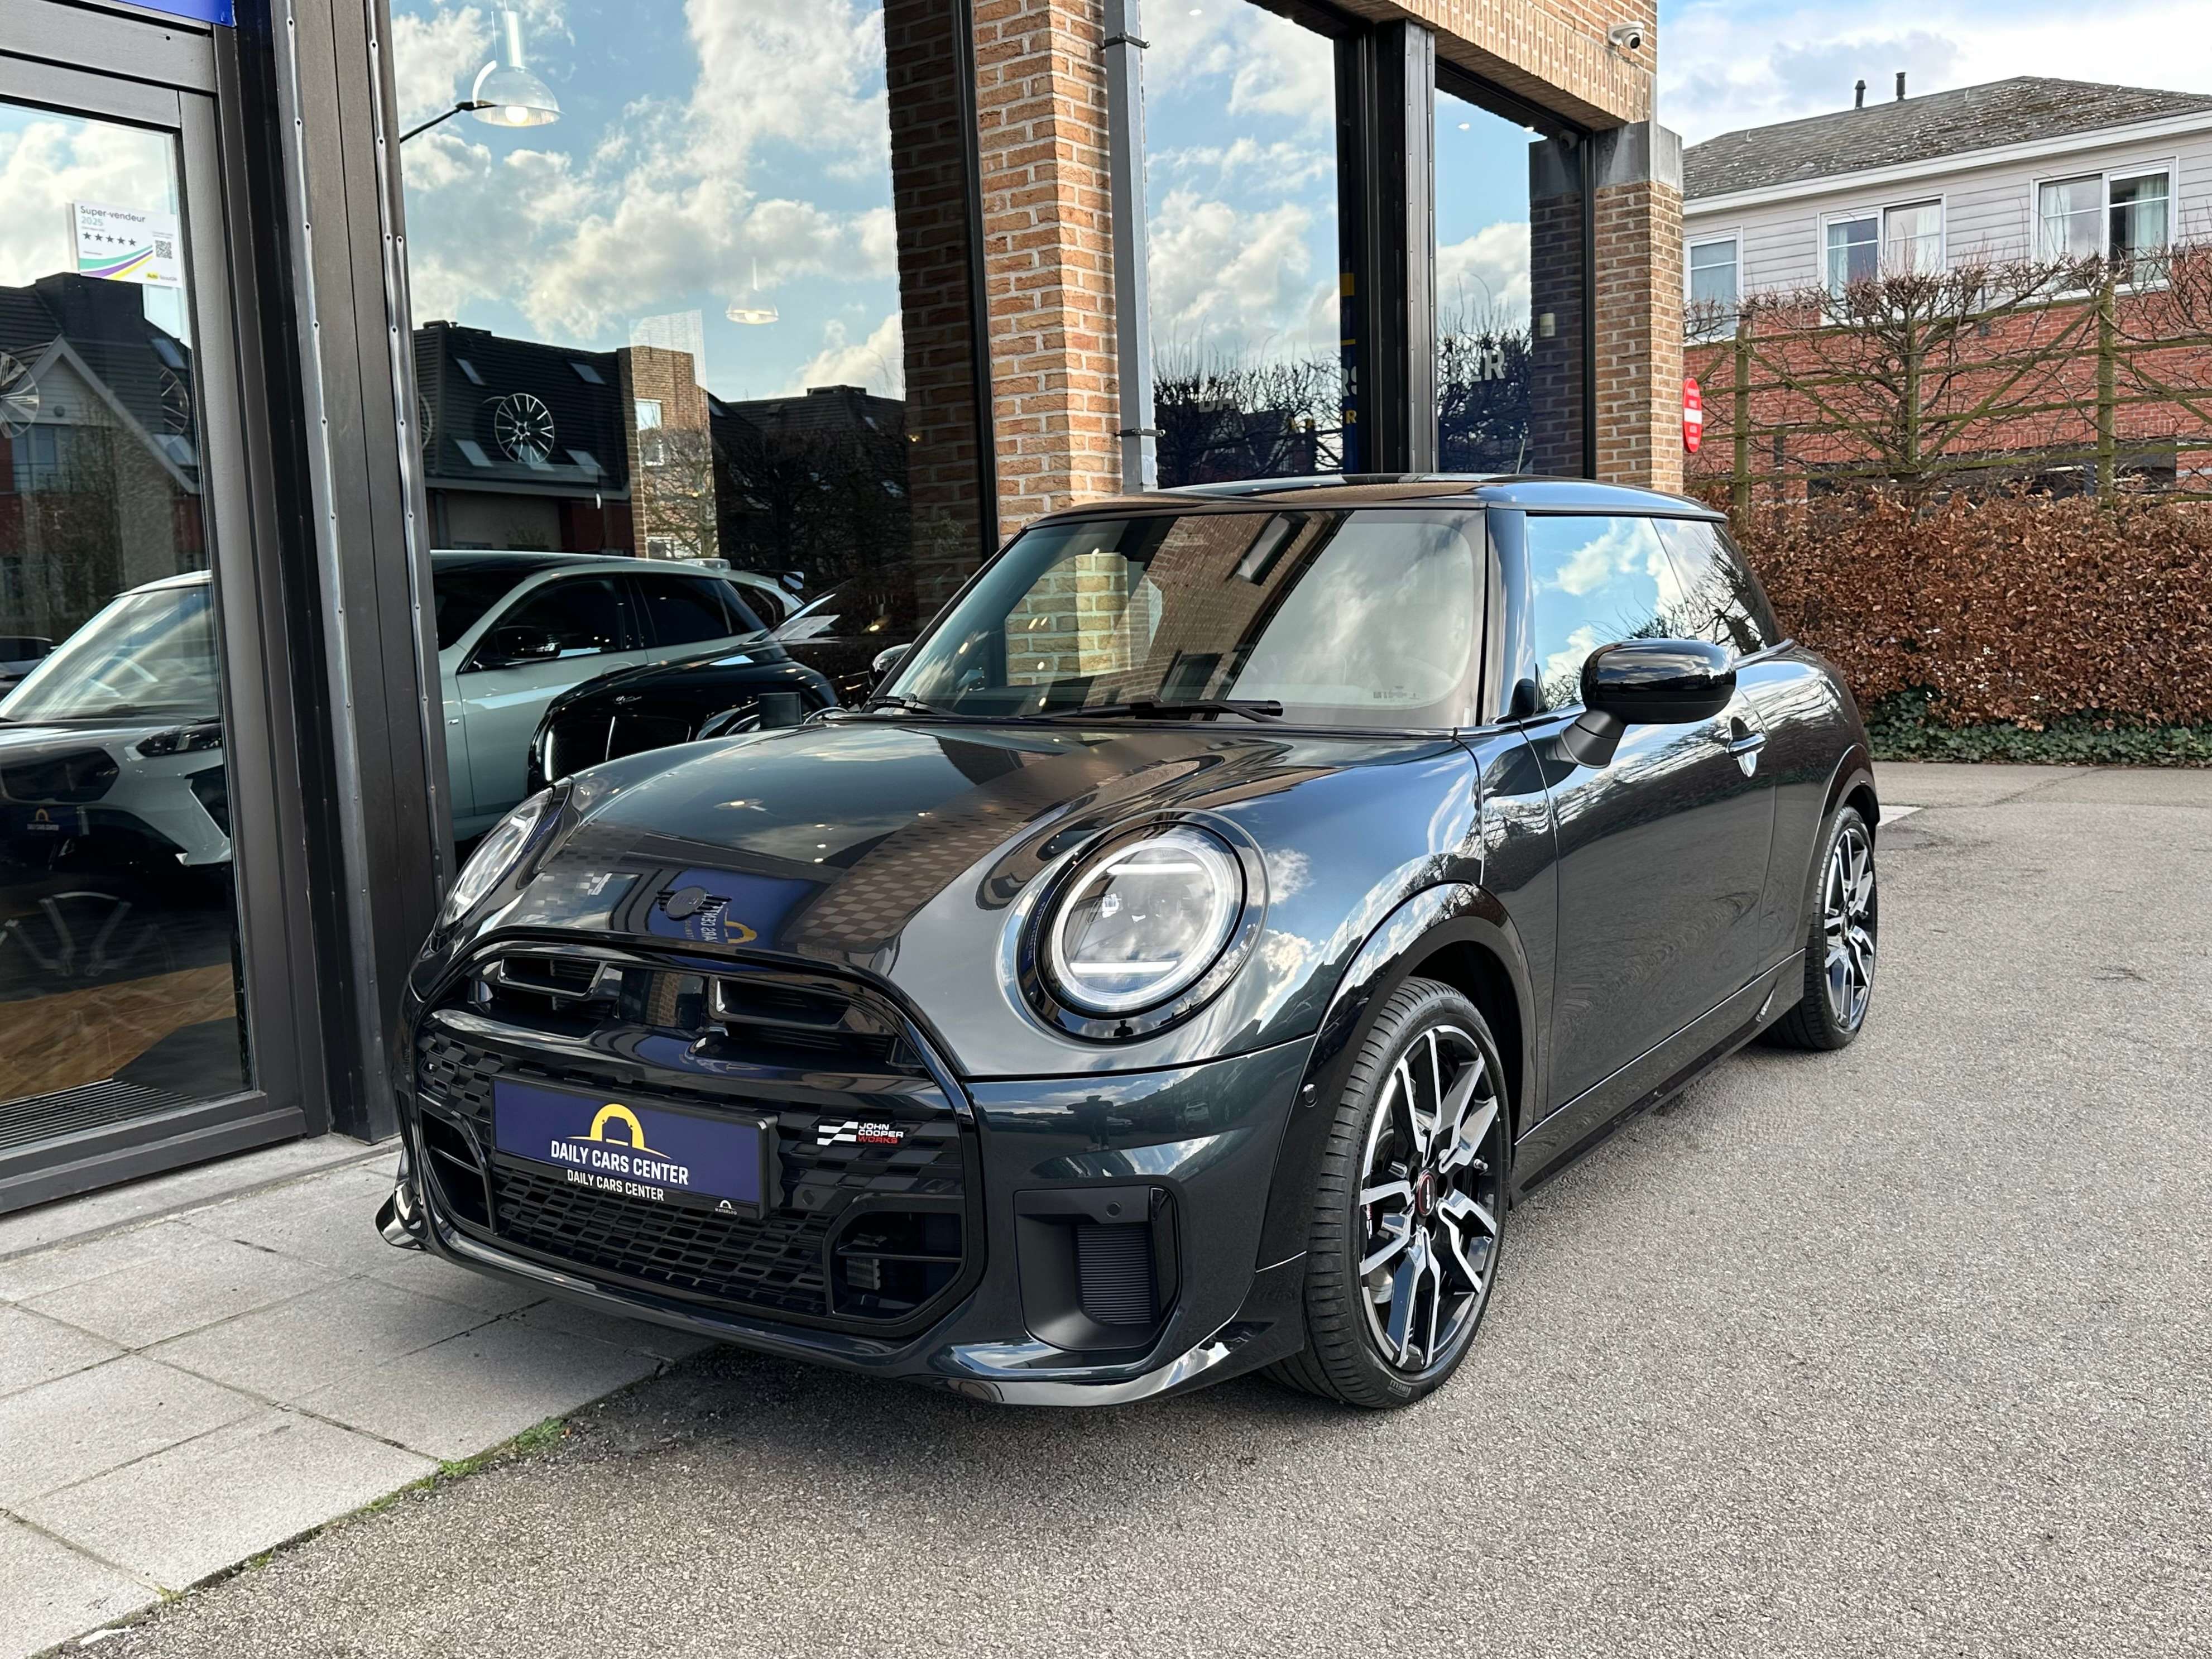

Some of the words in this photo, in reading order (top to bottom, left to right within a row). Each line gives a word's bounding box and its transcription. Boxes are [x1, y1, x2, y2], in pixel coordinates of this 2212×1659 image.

[80, 205, 145, 223] Super-vendeur
[81, 216, 103, 227] 2025
[858, 1129, 904, 1138] COOPER
[551, 1140, 589, 1164] DAILY
[592, 1149, 630, 1173] CARS
[633, 1158, 689, 1186] CENTER
[567, 1169, 594, 1186] DAILY
[596, 1176, 623, 1193] CARS
[625, 1182, 664, 1201] CENTER
[1388, 1379, 1412, 1398] PIRELLI
